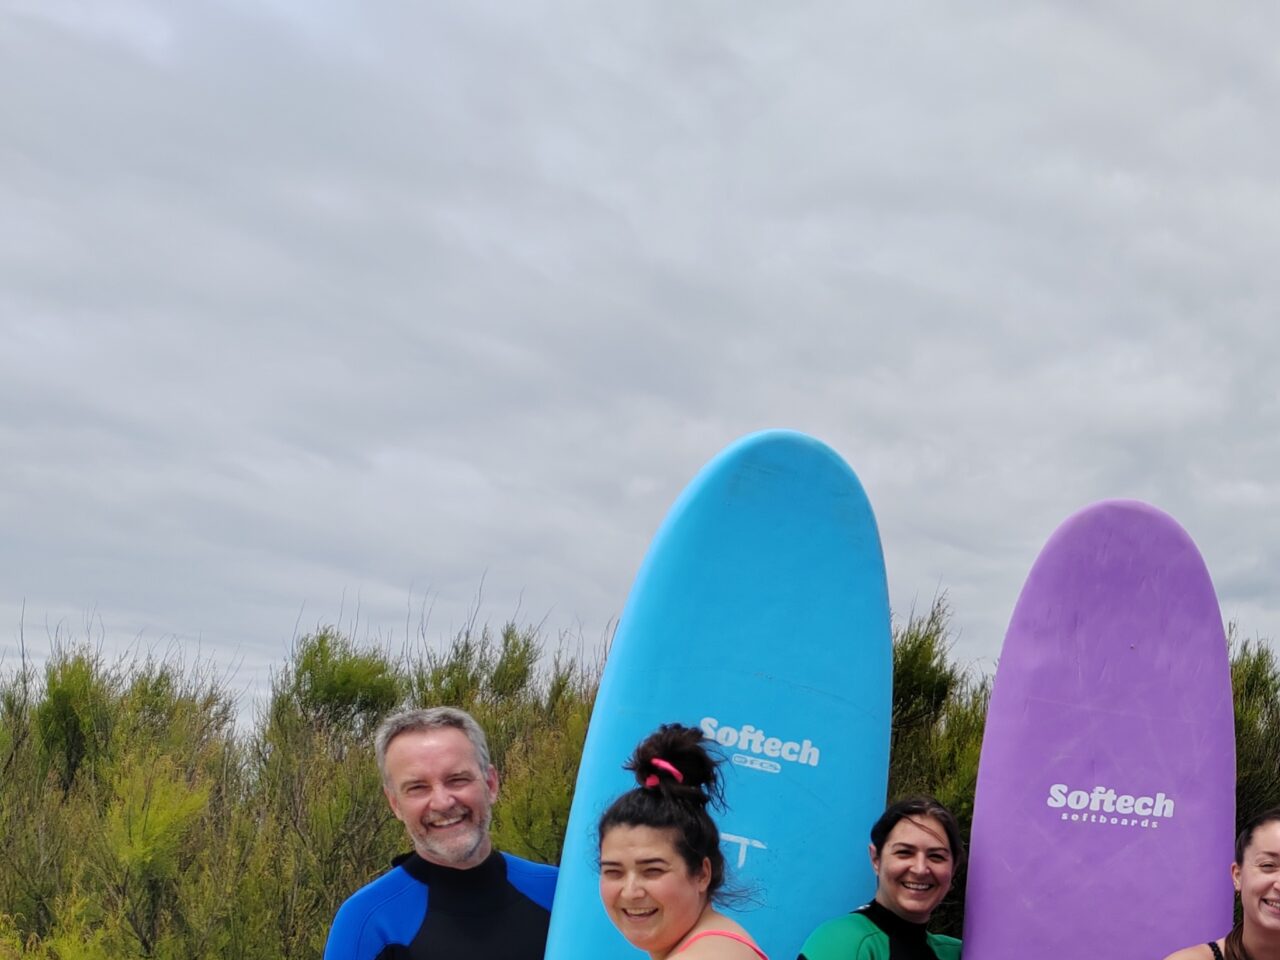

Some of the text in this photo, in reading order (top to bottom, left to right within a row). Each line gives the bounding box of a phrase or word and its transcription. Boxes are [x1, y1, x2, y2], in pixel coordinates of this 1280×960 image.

[700, 717, 820, 767] Softech
[1047, 783, 1175, 818] Softech
[1061, 812, 1158, 829] softboards
